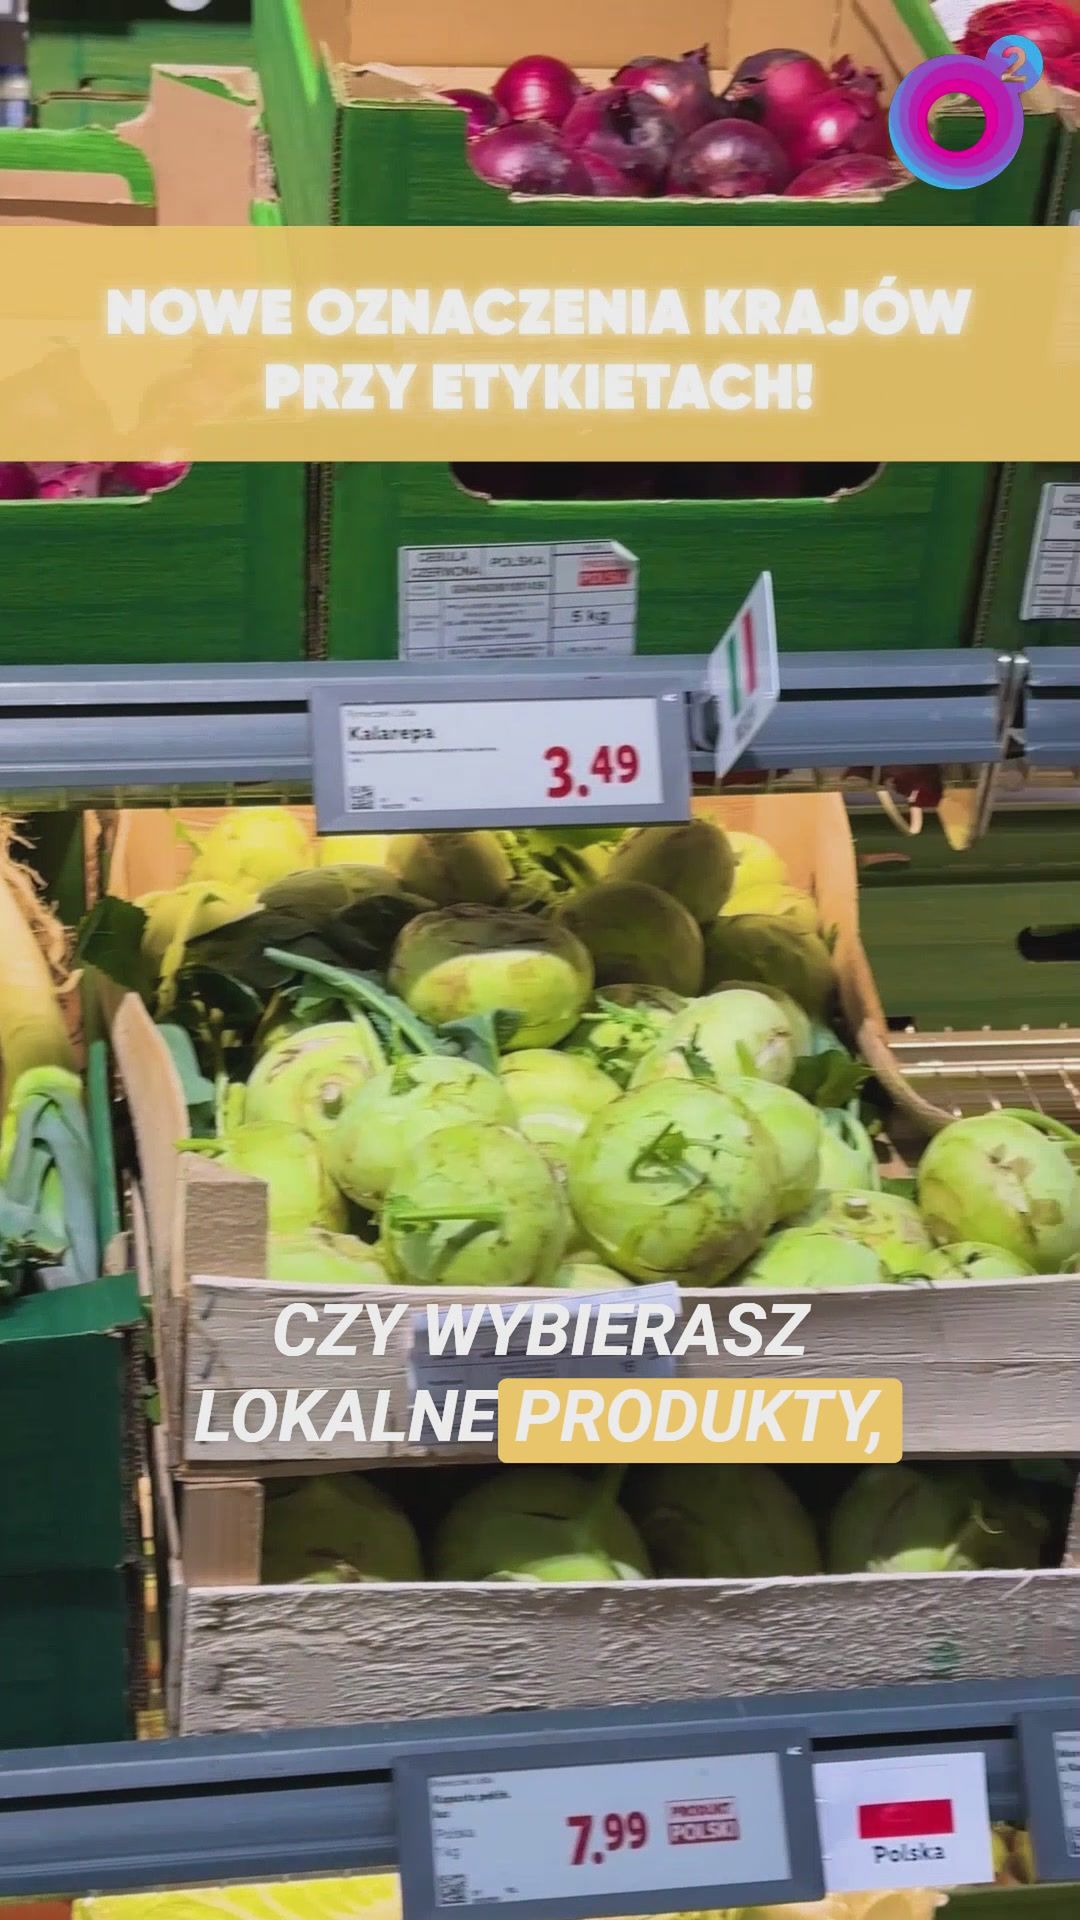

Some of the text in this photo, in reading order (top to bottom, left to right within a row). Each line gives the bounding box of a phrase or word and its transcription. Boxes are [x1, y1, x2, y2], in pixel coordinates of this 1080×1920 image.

[489, 556, 546, 568] POLSKA
[571, 610, 610, 625] 5 kg
[348, 726, 435, 743] Kalarepa
[544, 744, 640, 799] 3.49
[671, 1802, 731, 1817] PRODUKT
[565, 1811, 650, 1866] 7.99
[671, 1821, 737, 1843] POLSKI
[872, 1843, 946, 1864] Polska
